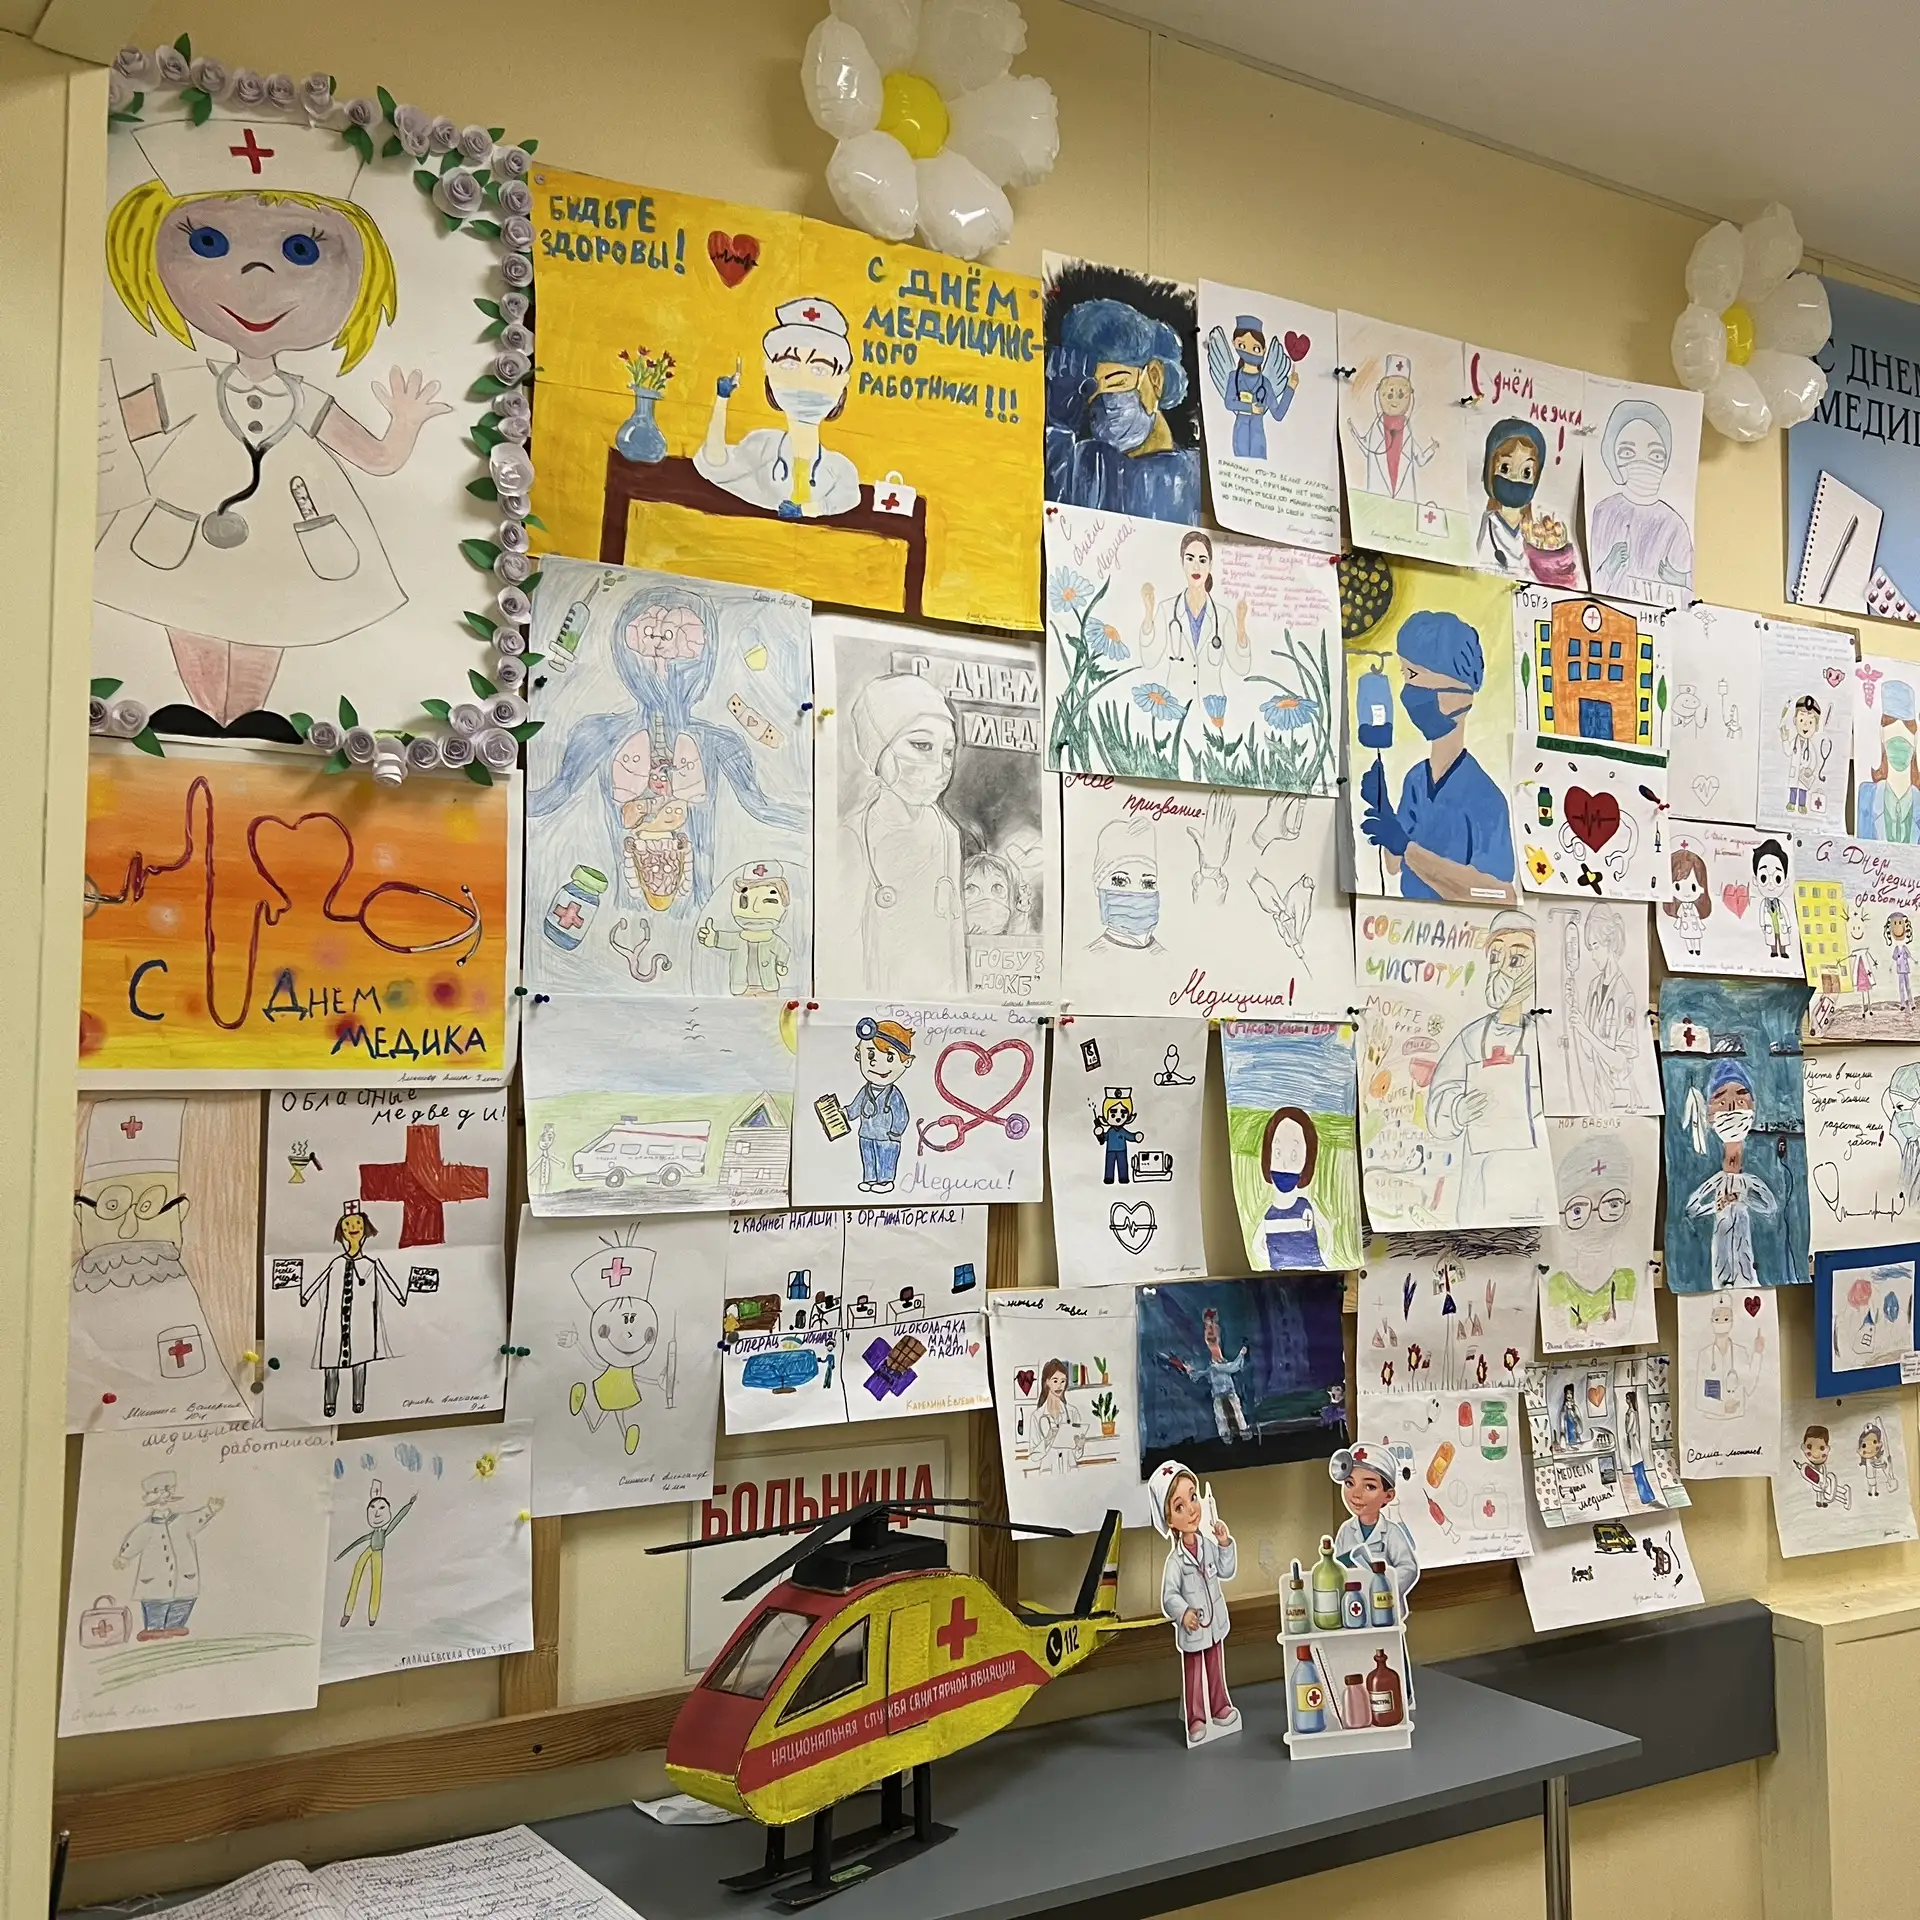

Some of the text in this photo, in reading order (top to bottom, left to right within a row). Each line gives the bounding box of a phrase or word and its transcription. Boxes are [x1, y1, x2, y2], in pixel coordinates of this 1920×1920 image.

[540, 228, 685, 274] ЗДОРОВЫ!
[867, 256, 1018, 321] С ДНЁМ
[863, 339, 917, 365] КОГО
[1812, 390, 1920, 447] МЕДИ
[128, 959, 382, 1022] С ДНЕМ
[1170, 968, 1295, 1017] Медицина!
[331, 1024, 486, 1061] МЕДИКА
[900, 1162, 1014, 1200] Медики!
[733, 1220, 740, 1234] 2
[847, 1212, 853, 1224] 3
[701, 1464, 936, 1541] БОЛЬНИЦА
[1064, 1625, 1080, 1654] 112
[771, 1718, 859, 1768] НАЦИОНАЛЬНАЯ
[908, 1672, 969, 1712] САНИТАРНОЙ
[970, 1659, 1017, 1688] АВИАЦИИ
